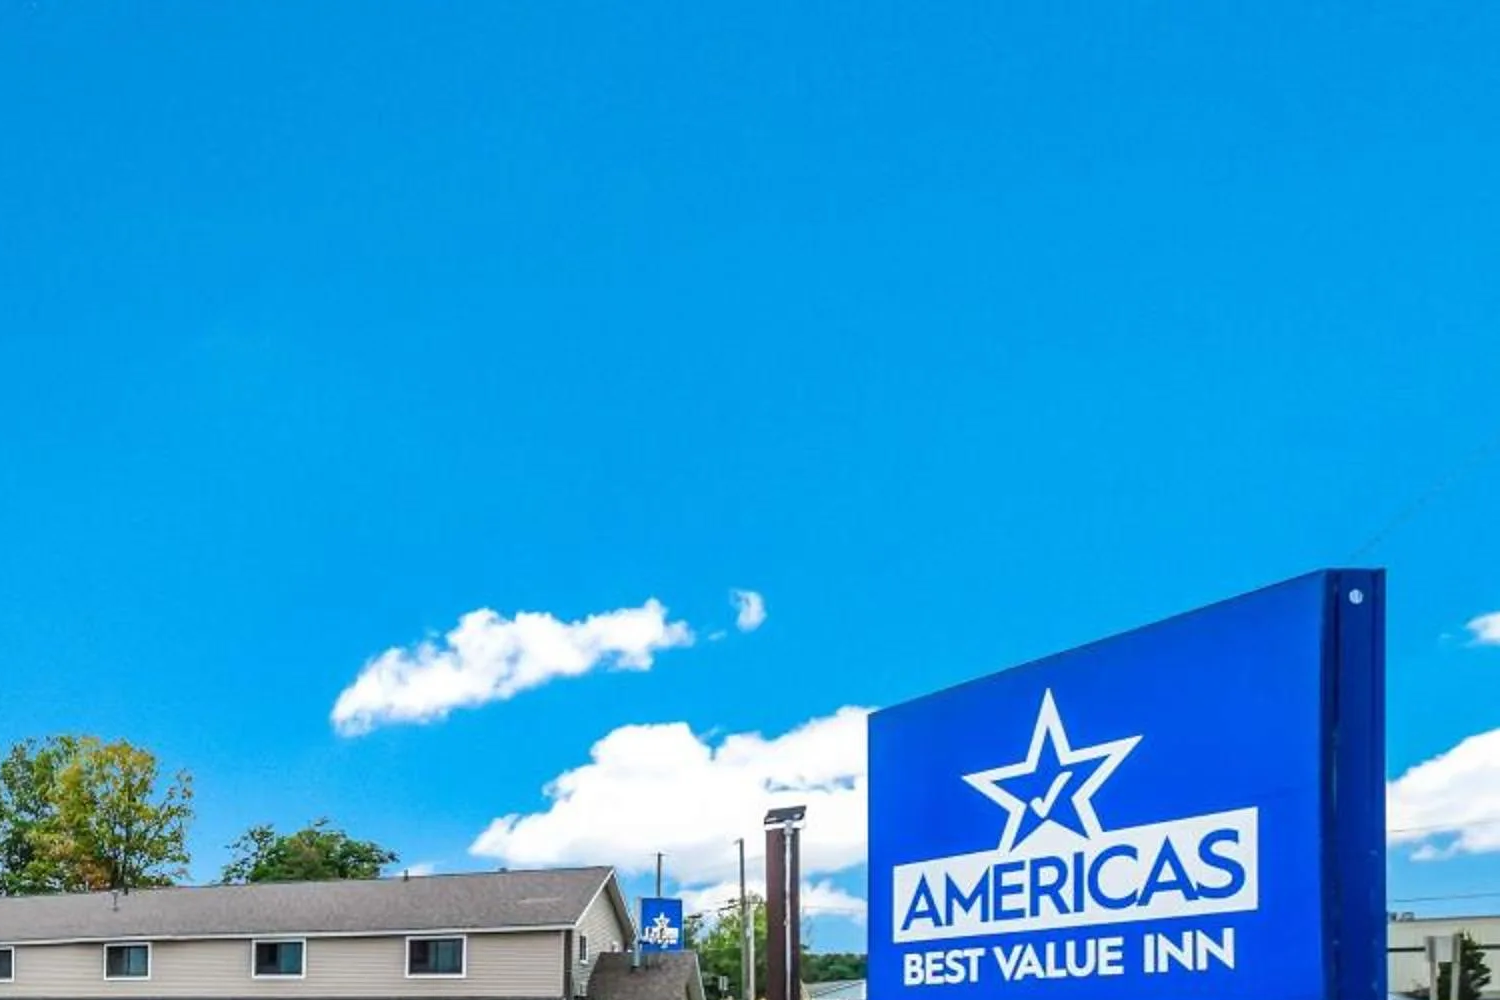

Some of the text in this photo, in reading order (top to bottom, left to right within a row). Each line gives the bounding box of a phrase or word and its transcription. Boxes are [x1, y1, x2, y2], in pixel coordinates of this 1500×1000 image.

[901, 829, 1246, 931] AMERICAS
[903, 927, 1235, 986] BEST VALUE INN
